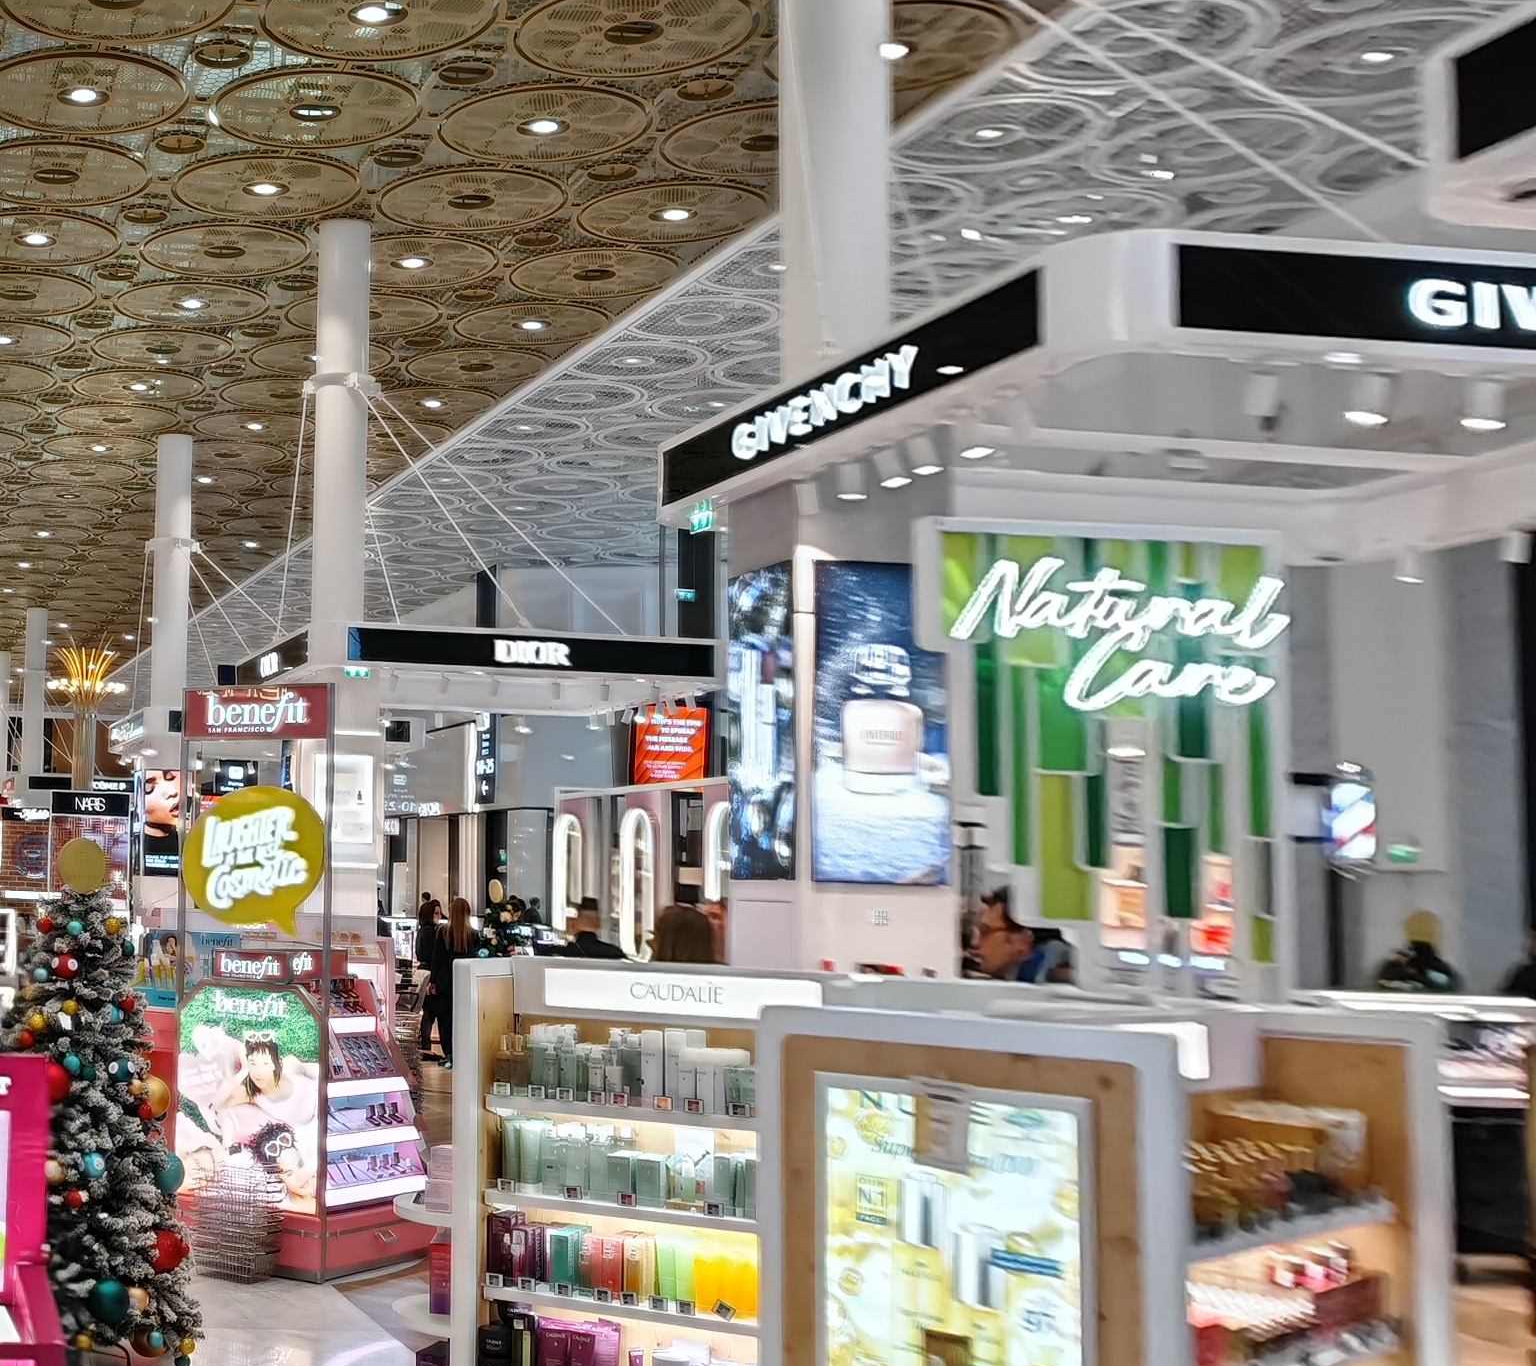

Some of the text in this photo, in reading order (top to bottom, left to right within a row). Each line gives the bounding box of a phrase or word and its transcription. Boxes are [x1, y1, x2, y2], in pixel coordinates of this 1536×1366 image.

[732, 344, 919, 460] GIVENCHY
[949, 556, 1291, 652] Natural
[493, 639, 573, 666] DIOR
[1064, 631, 1276, 712] Care
[206, 691, 307, 733] benefit
[224, 726, 265, 734] FRANCISCO
[75, 797, 105, 811] NARS
[201, 936, 233, 947] benefit
[220, 953, 280, 979] benefit
[214, 989, 286, 1021] benefit
[858, 1177, 885, 1188] OUR
